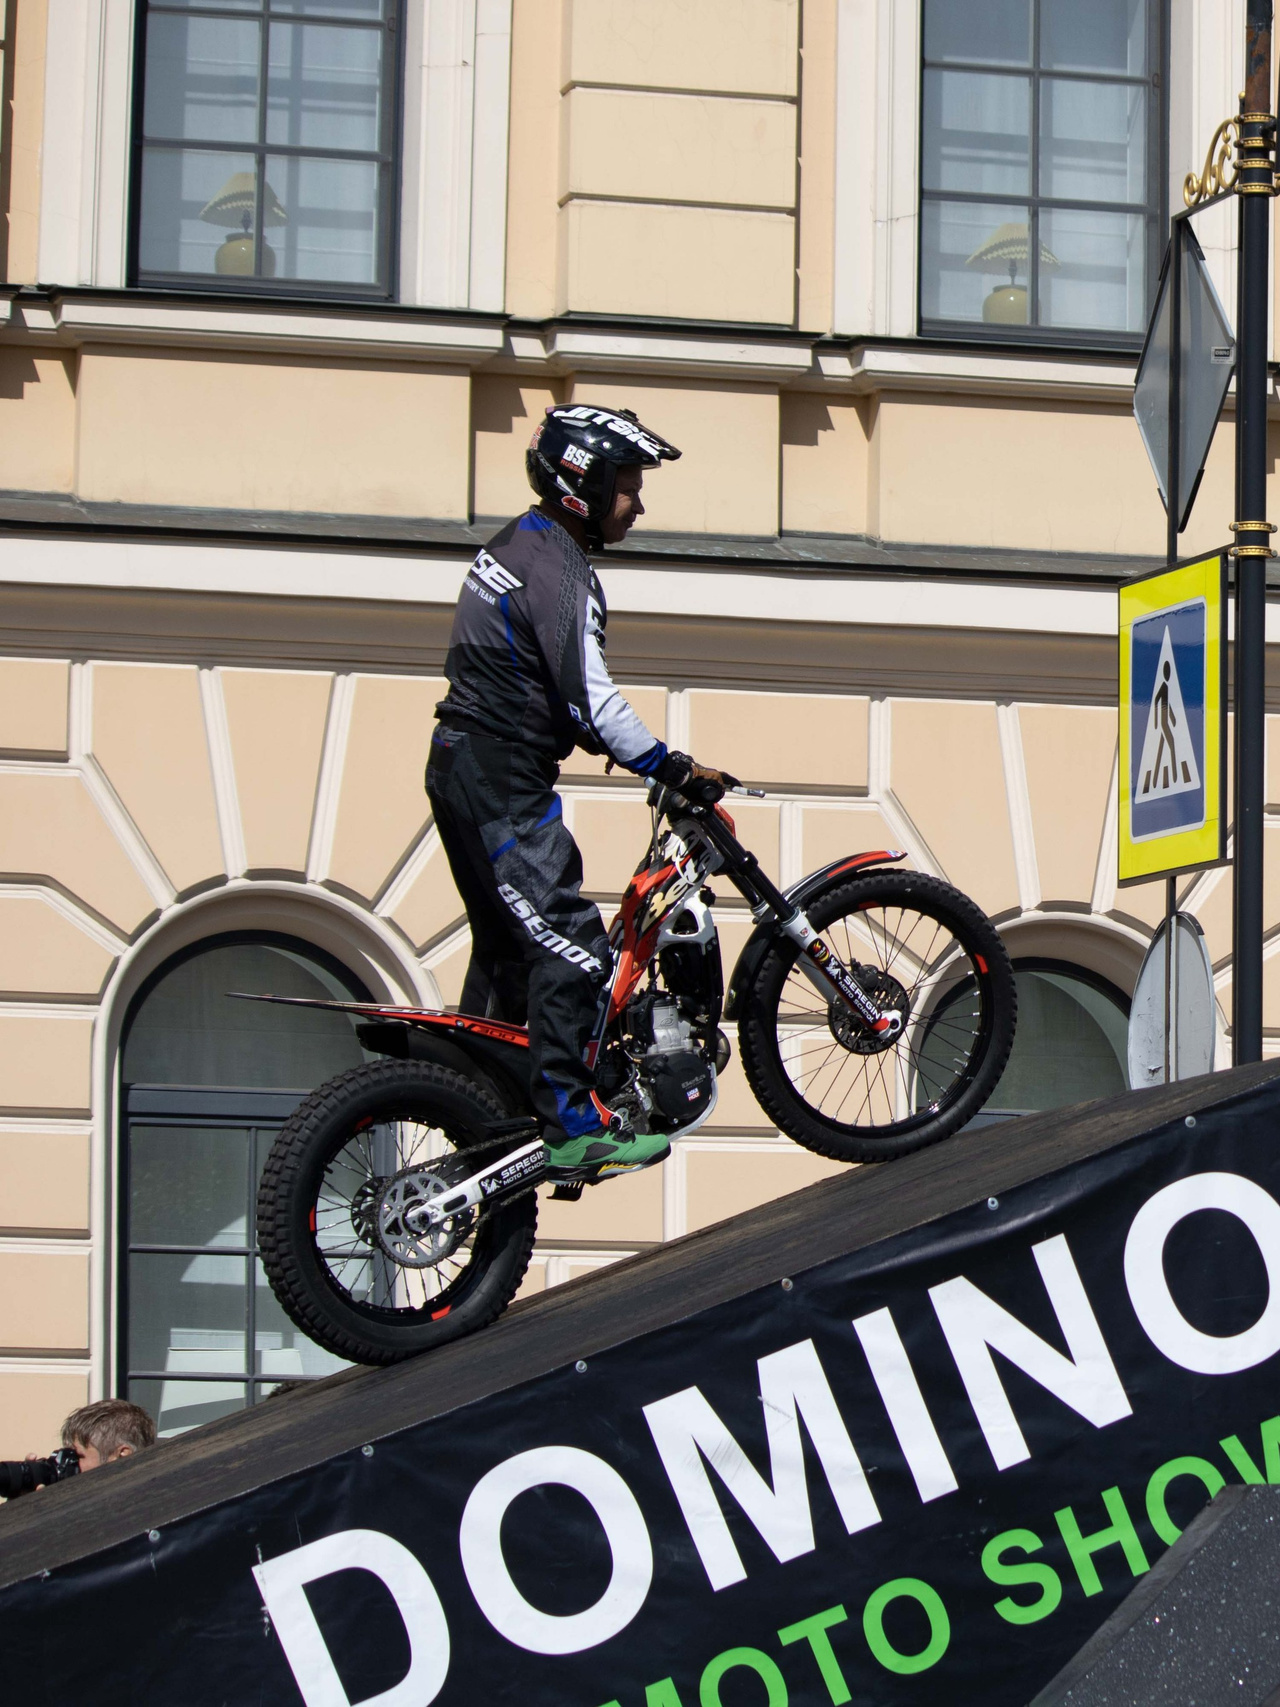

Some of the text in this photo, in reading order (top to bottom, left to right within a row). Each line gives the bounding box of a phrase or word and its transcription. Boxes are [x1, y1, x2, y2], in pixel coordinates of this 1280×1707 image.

[560, 459, 585, 475] RUSSIA
[563, 444, 594, 470] BSE
[471, 548, 524, 594] SE
[478, 588, 496, 606] TEAM
[838, 981, 875, 1023] MOTO SCHOOL
[843, 975, 881, 1020] SEREGIN
[503, 1160, 546, 1185] MOTO SCHOO
[598, 1577, 951, 1707] OTO
